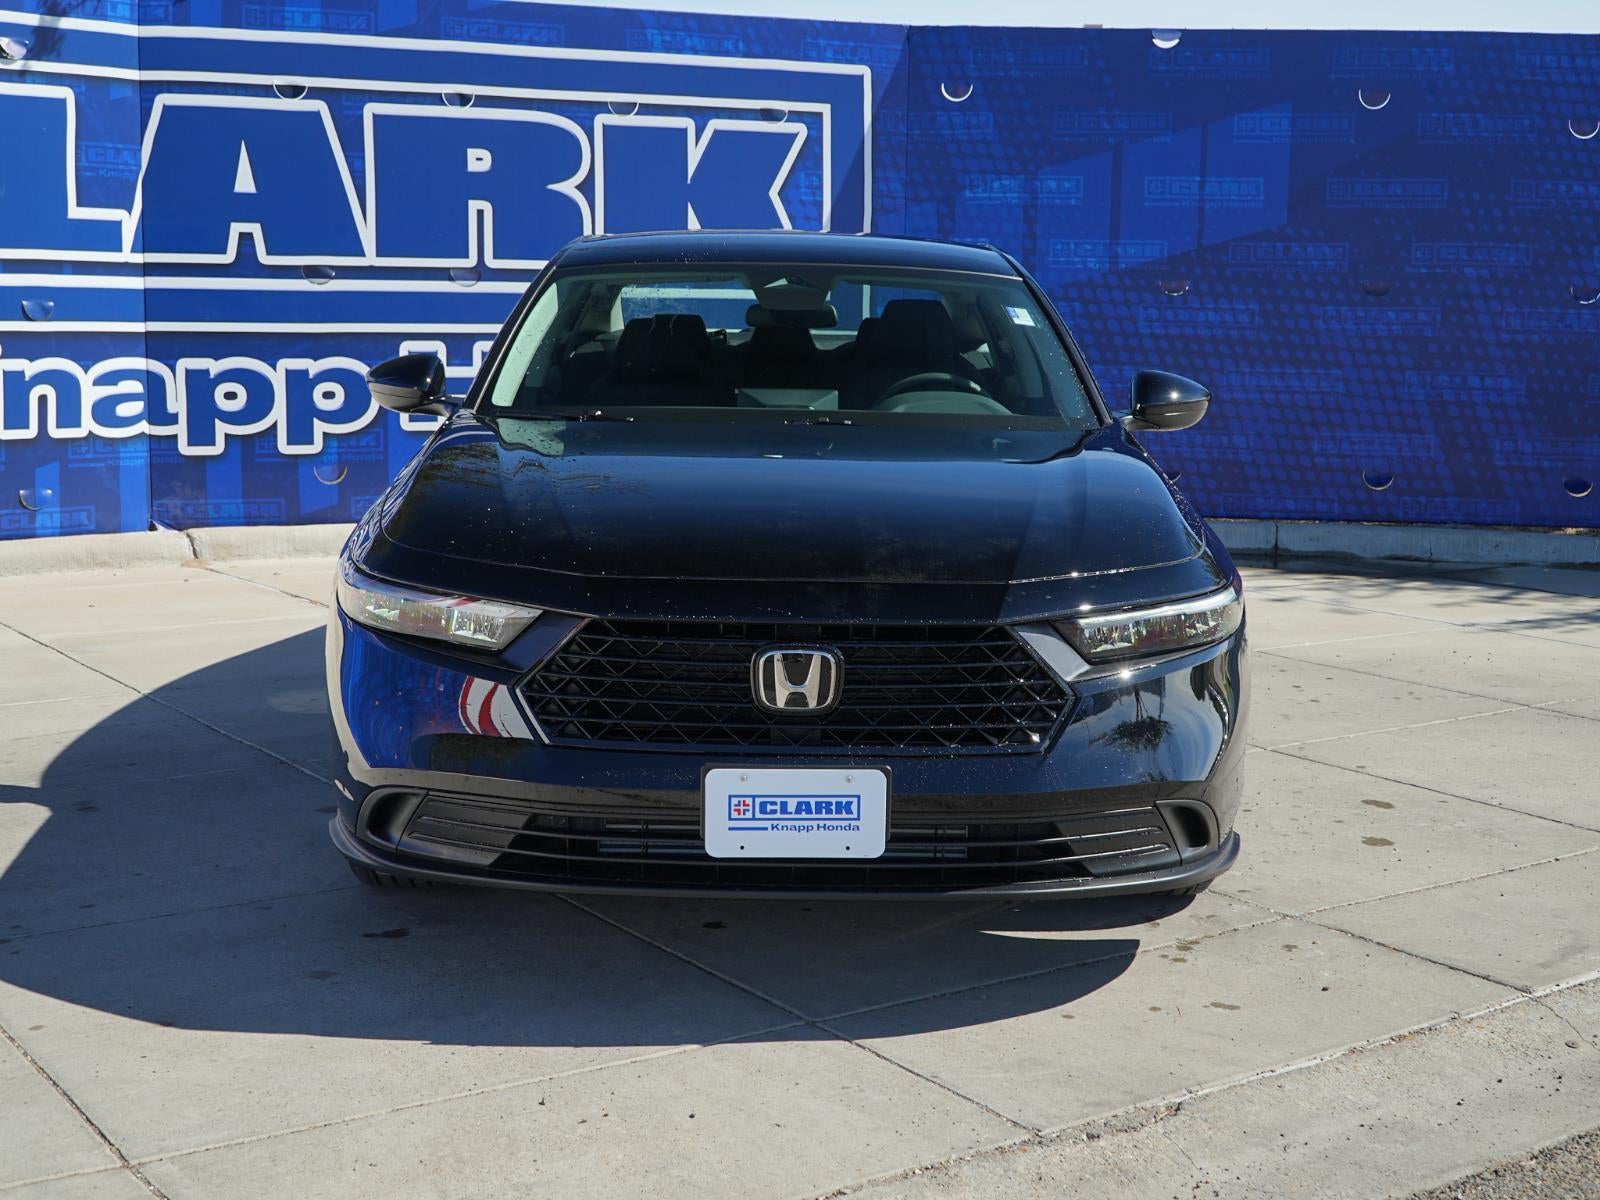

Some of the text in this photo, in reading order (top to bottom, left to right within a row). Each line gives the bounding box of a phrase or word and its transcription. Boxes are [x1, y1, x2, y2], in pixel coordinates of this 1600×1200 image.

[0, 355, 380, 456] napp
[759, 800, 854, 815] CLARK
[770, 823, 860, 833] Knapp Honda
